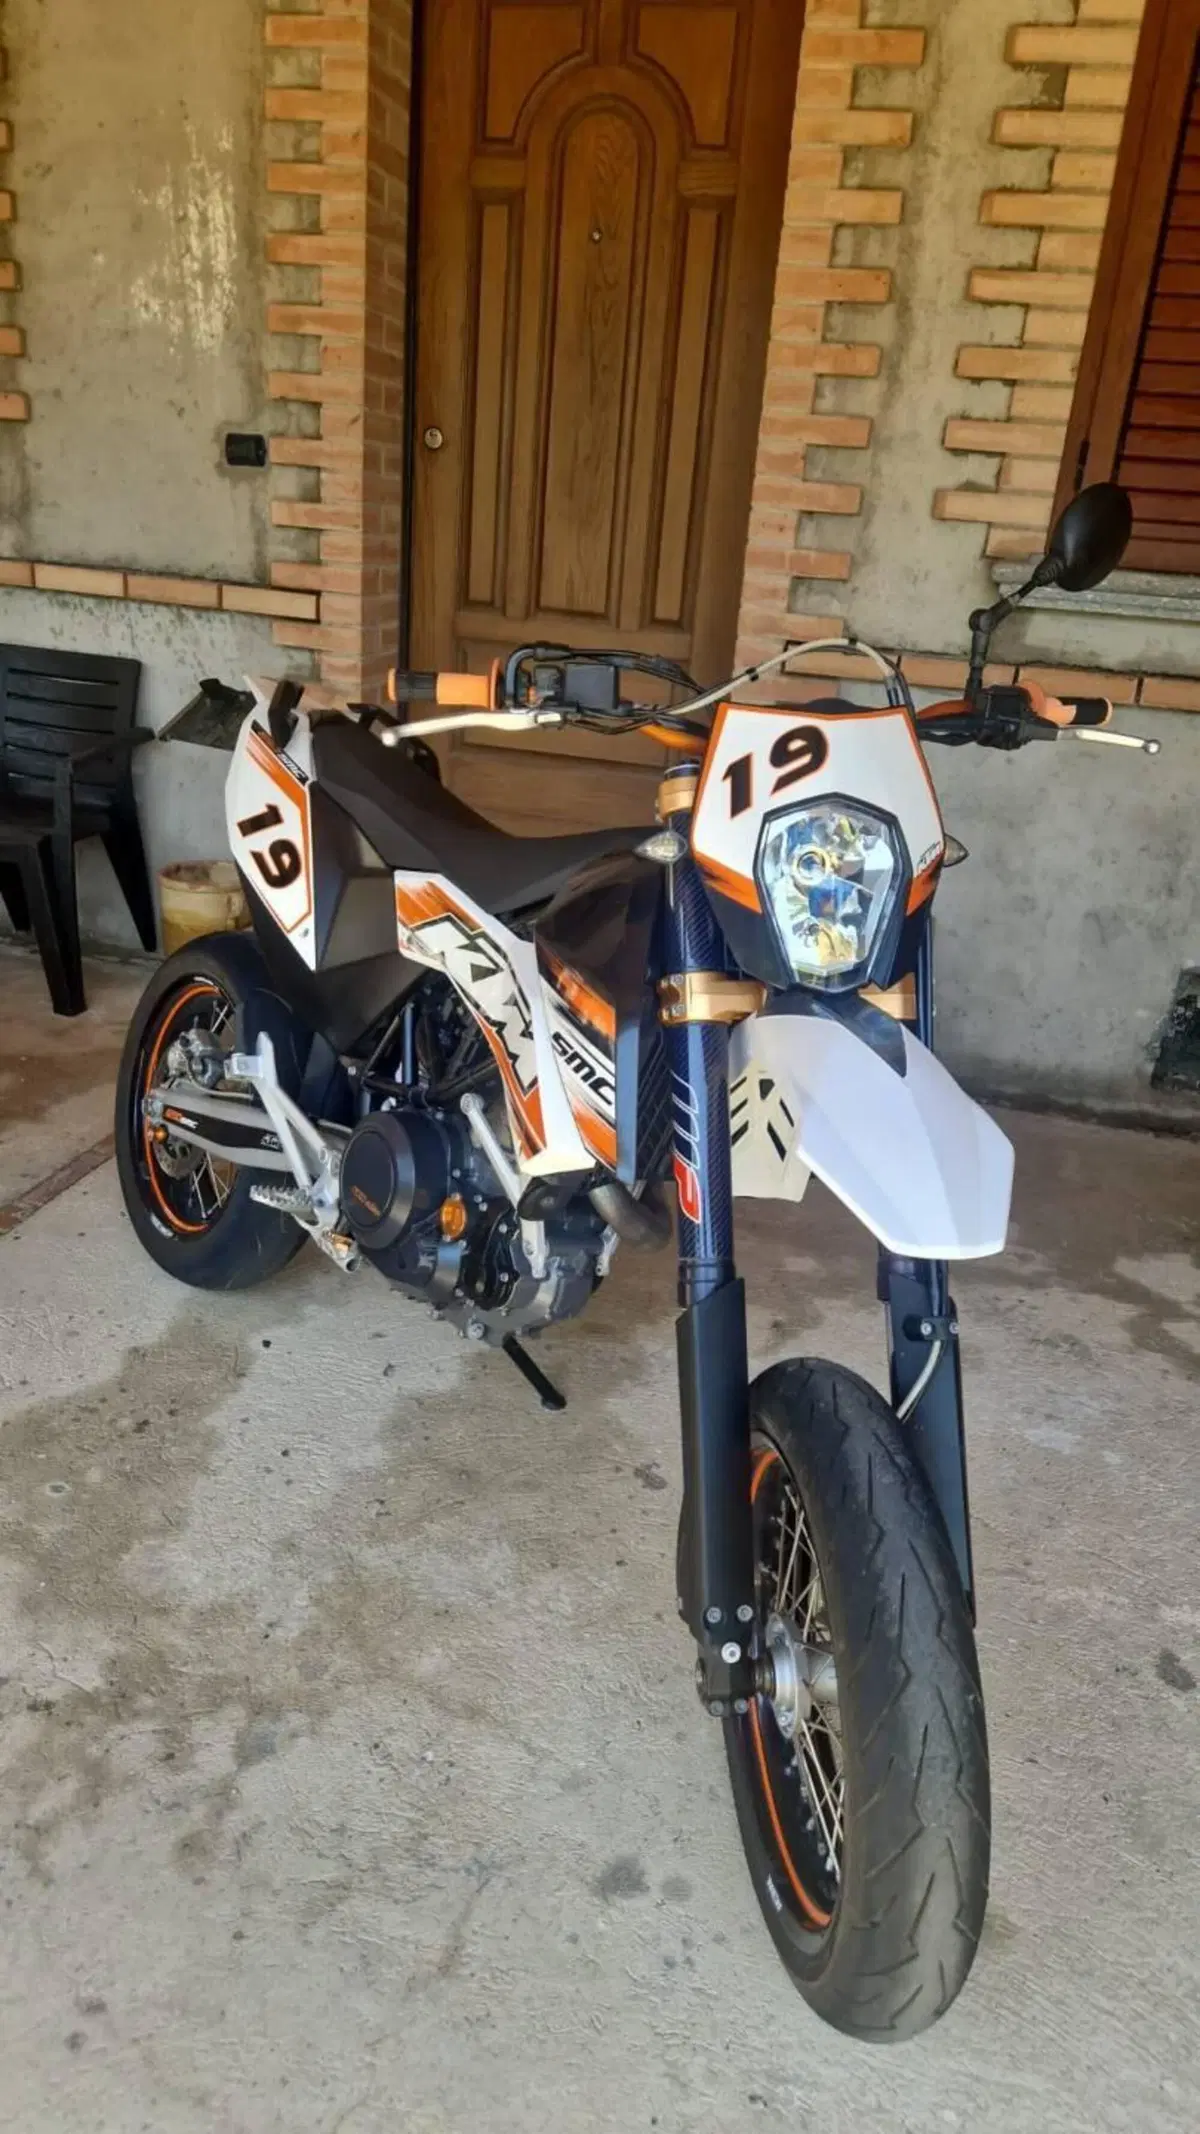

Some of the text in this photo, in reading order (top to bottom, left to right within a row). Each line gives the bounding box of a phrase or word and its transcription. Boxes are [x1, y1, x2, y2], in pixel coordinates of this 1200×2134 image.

[722, 725, 829, 819] 19
[236, 803, 302, 889] 19
[411, 919, 539, 1093] KTM
